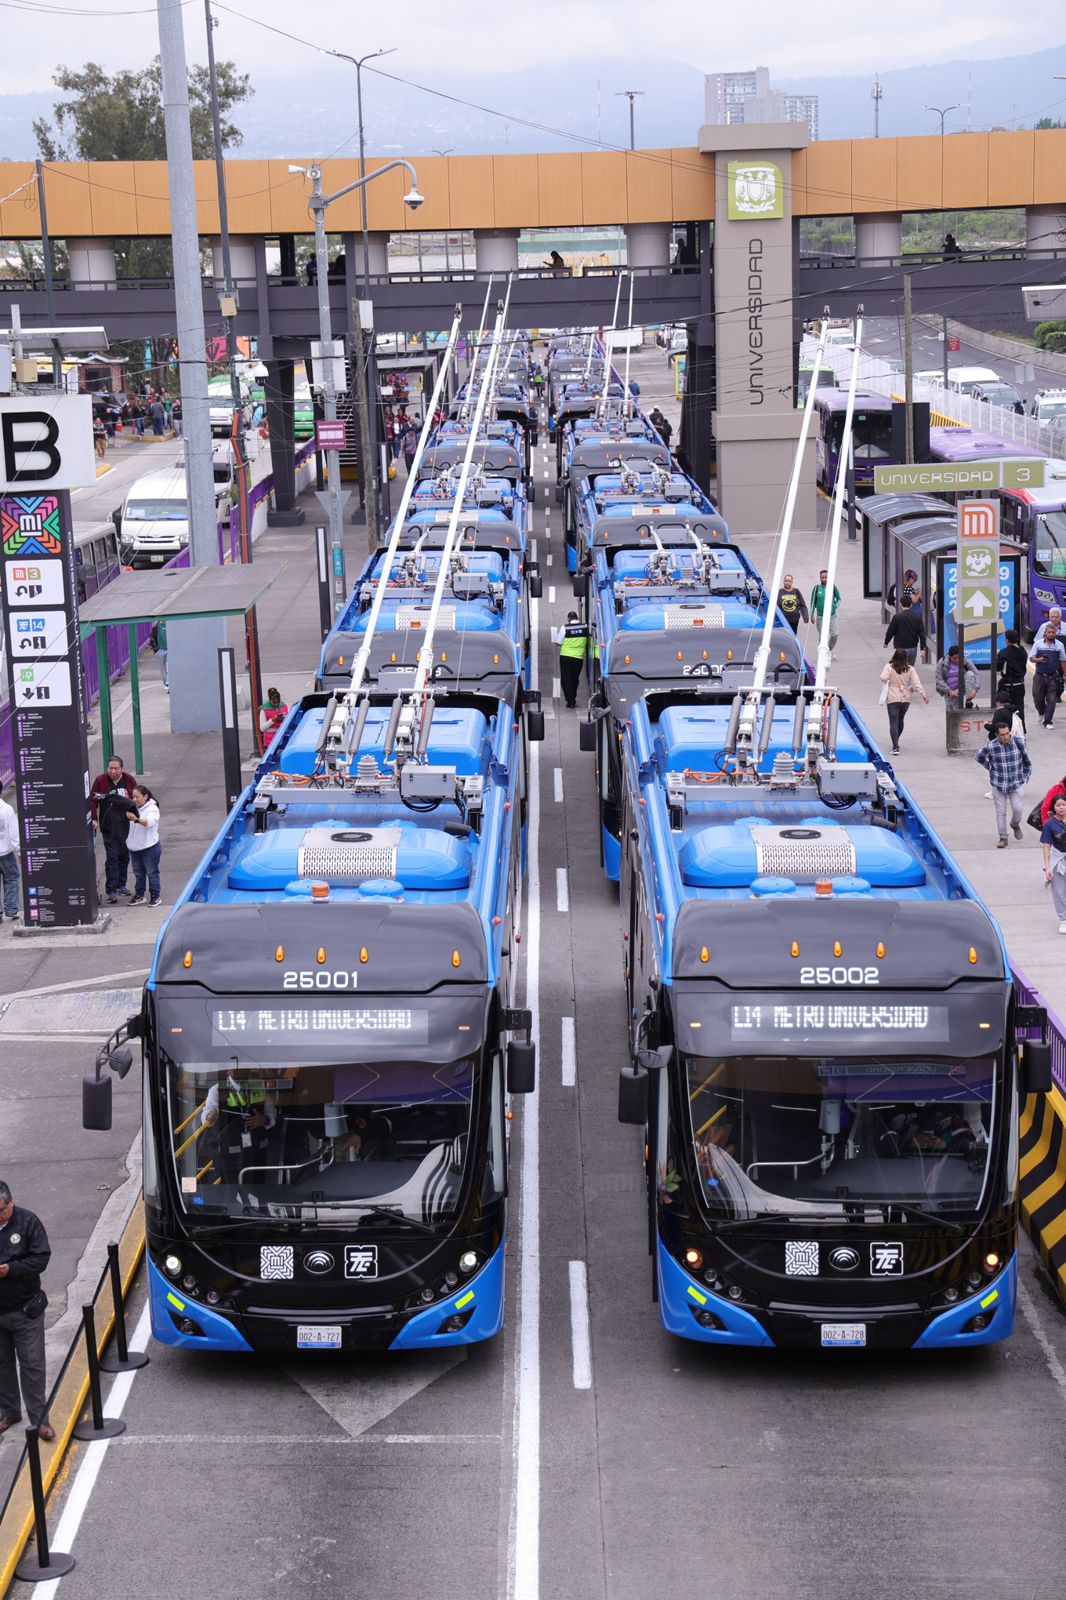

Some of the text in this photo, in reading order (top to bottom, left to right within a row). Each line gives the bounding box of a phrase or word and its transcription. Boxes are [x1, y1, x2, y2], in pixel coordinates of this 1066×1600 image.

[748, 238, 764, 405] UNIVERSIDAD
[1, 411, 61, 482] B
[880, 468, 1031, 486] UNIVERSIDAD 3
[283, 971, 357, 988] 25001
[800, 967, 879, 984] 25002
[774, 1006, 824, 1028] METRO
[828, 1006, 928, 1028] UNIVERSIDAD
